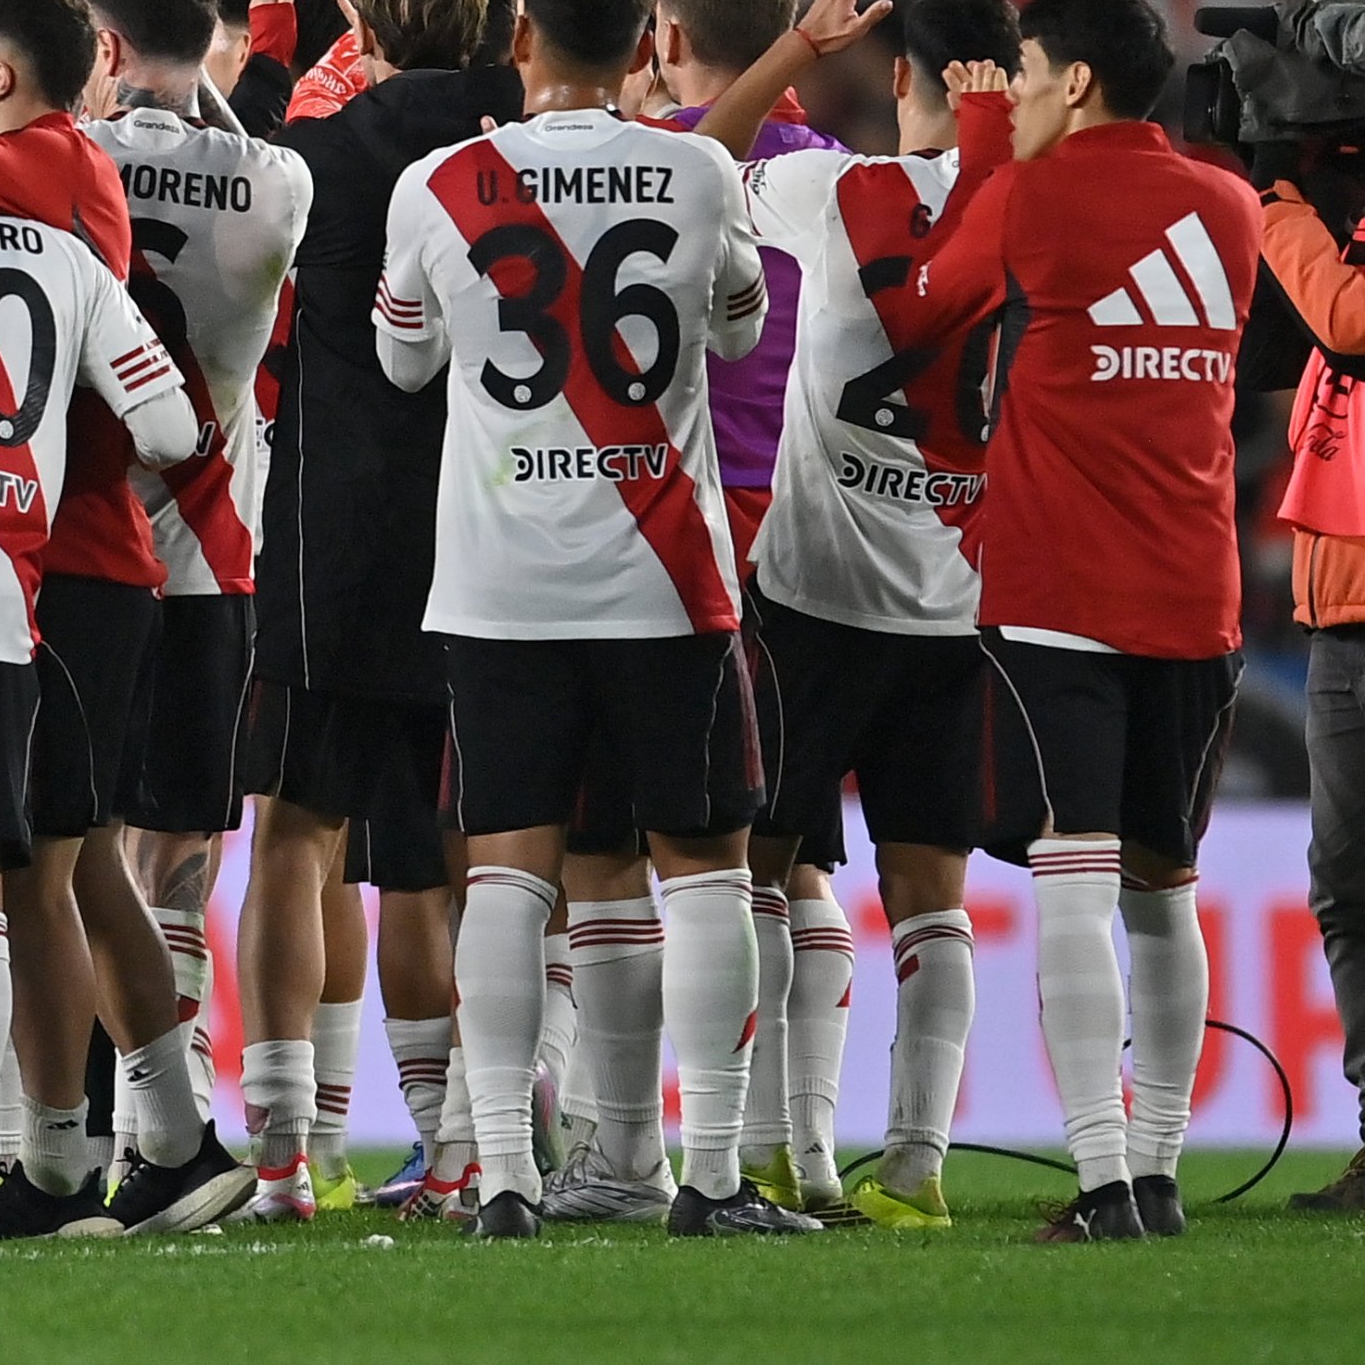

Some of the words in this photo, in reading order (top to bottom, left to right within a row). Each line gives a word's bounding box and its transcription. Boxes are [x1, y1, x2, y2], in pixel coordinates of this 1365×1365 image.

[134, 120, 180, 134] Grandeza
[477, 171, 510, 206] U.
[516, 166, 675, 204] GIMENEZ
[466, 218, 681, 412] 36
[1089, 344, 1232, 384] DIRECTV
[510, 445, 668, 482] DIRECTV
